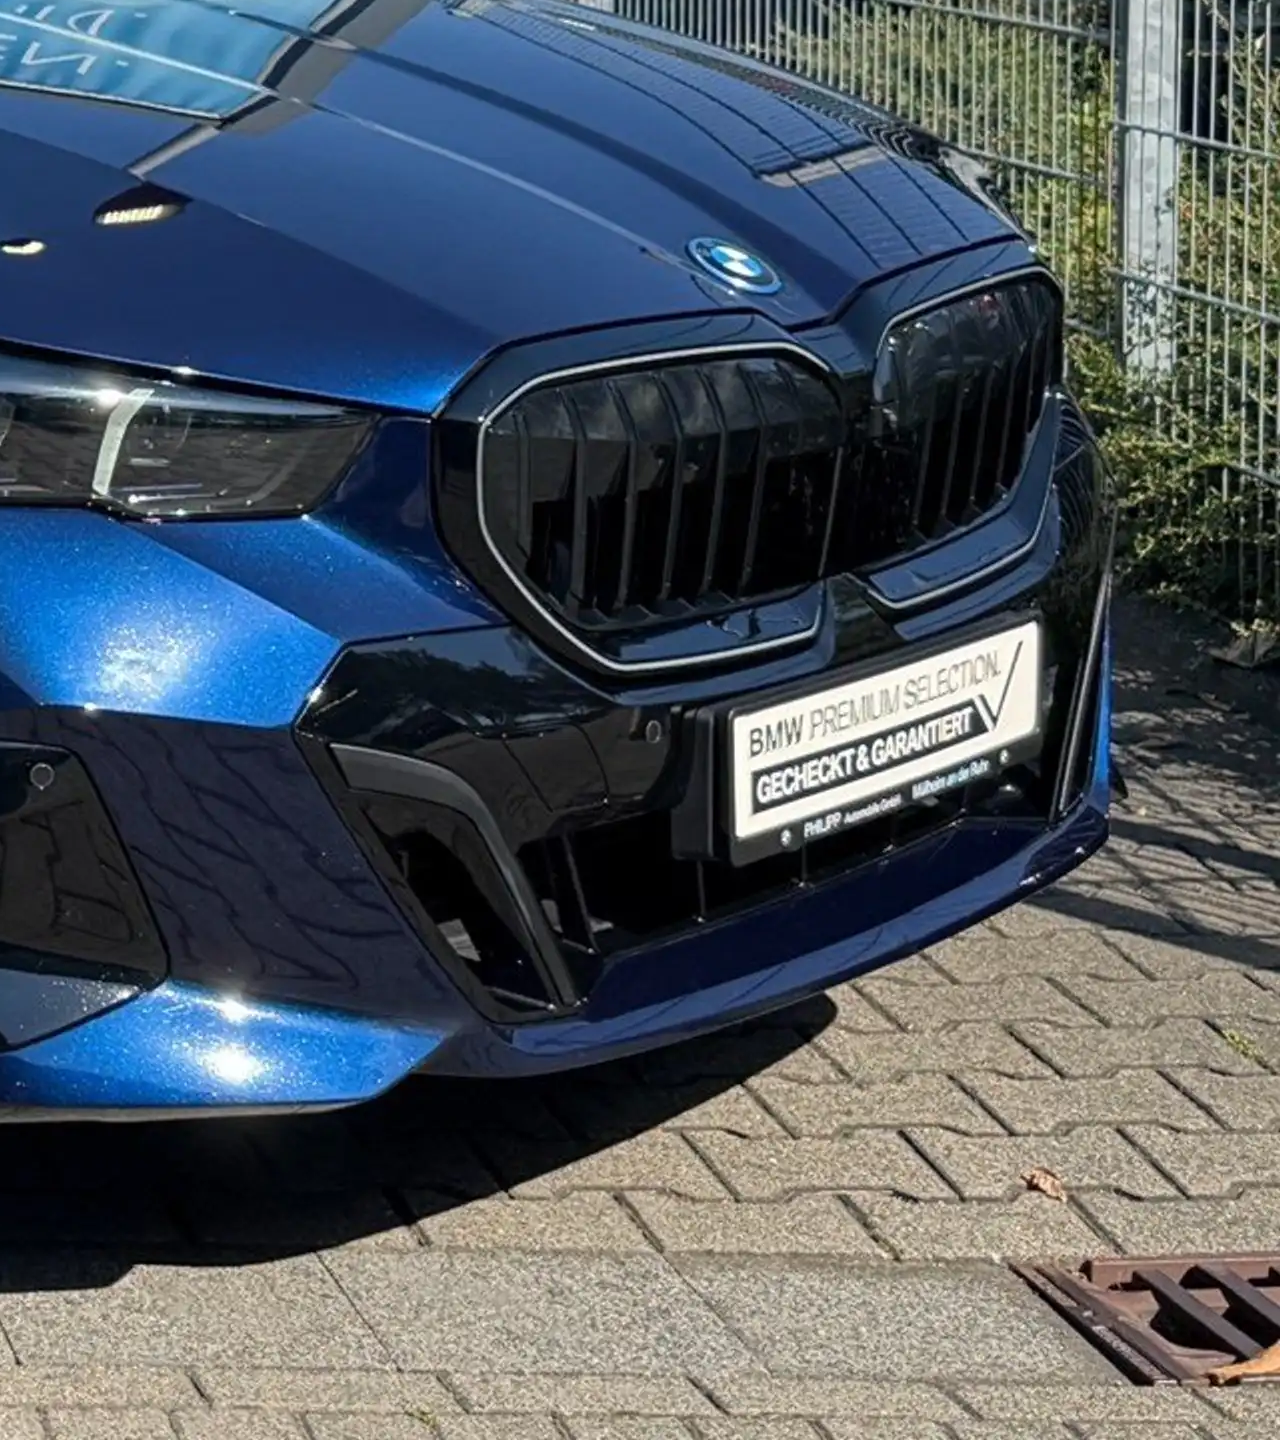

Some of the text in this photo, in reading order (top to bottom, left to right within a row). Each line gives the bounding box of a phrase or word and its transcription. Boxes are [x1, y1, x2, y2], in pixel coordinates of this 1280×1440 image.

[749, 649, 1002, 758] BMW PREMIUM SELECTION.
[756, 705, 975, 804] GECHECKT & GARANTIERT
[803, 812, 842, 838] PHILIPP
